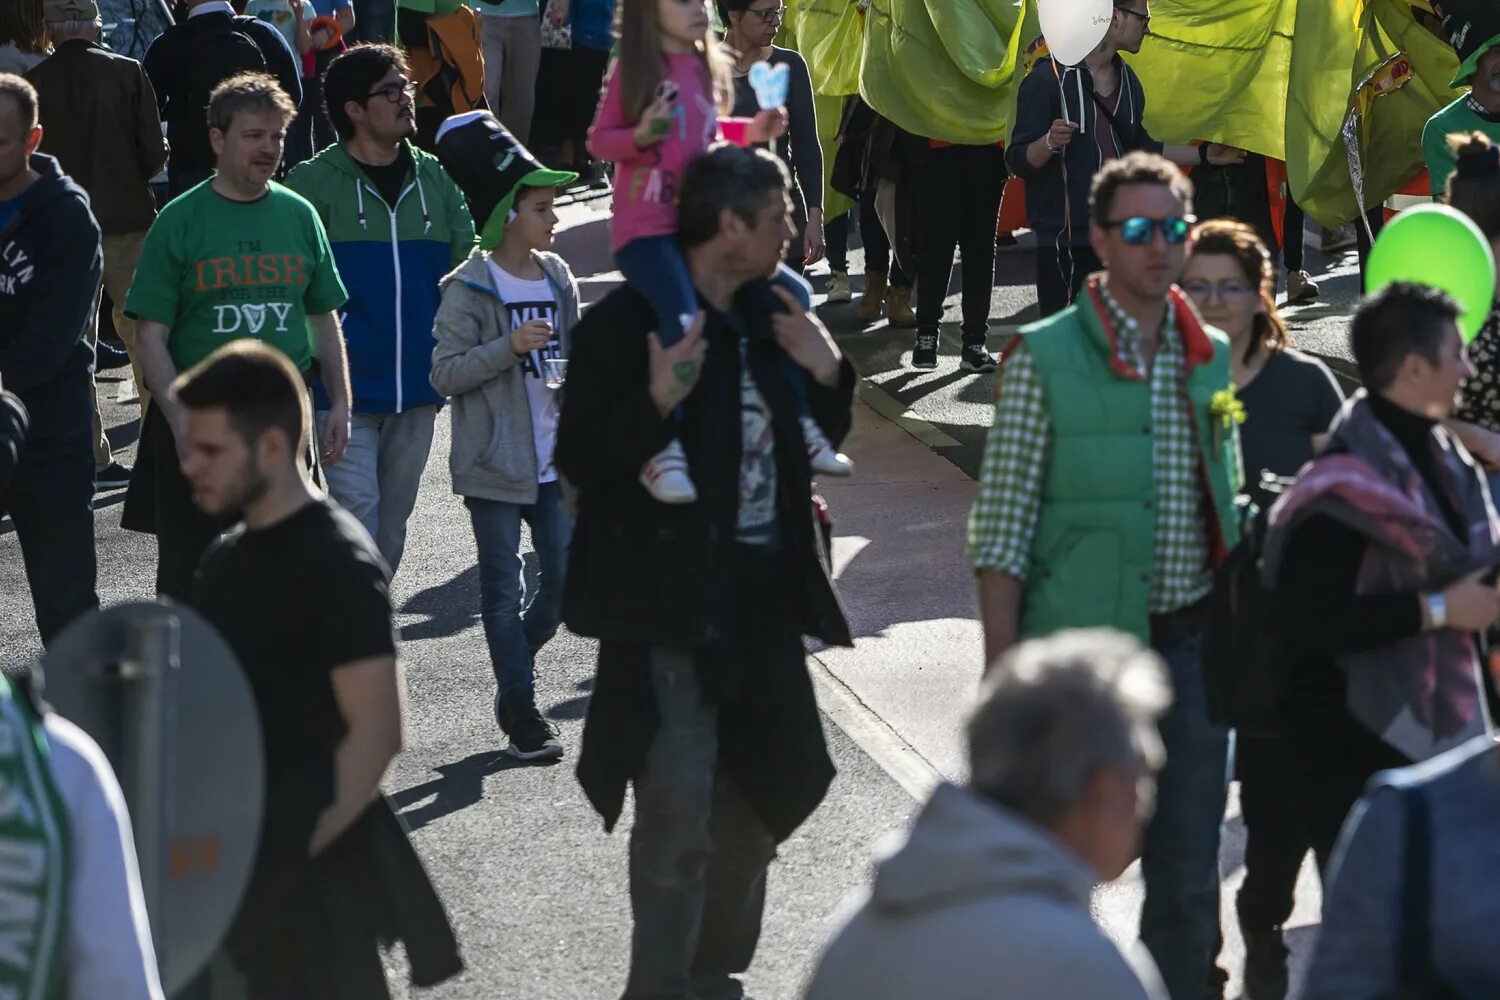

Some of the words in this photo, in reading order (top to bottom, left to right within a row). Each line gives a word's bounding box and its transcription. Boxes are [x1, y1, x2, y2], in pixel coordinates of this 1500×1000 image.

[194, 254, 305, 292] IRISH
[221, 287, 251, 300] FOR
[254, 286, 287, 300] THE
